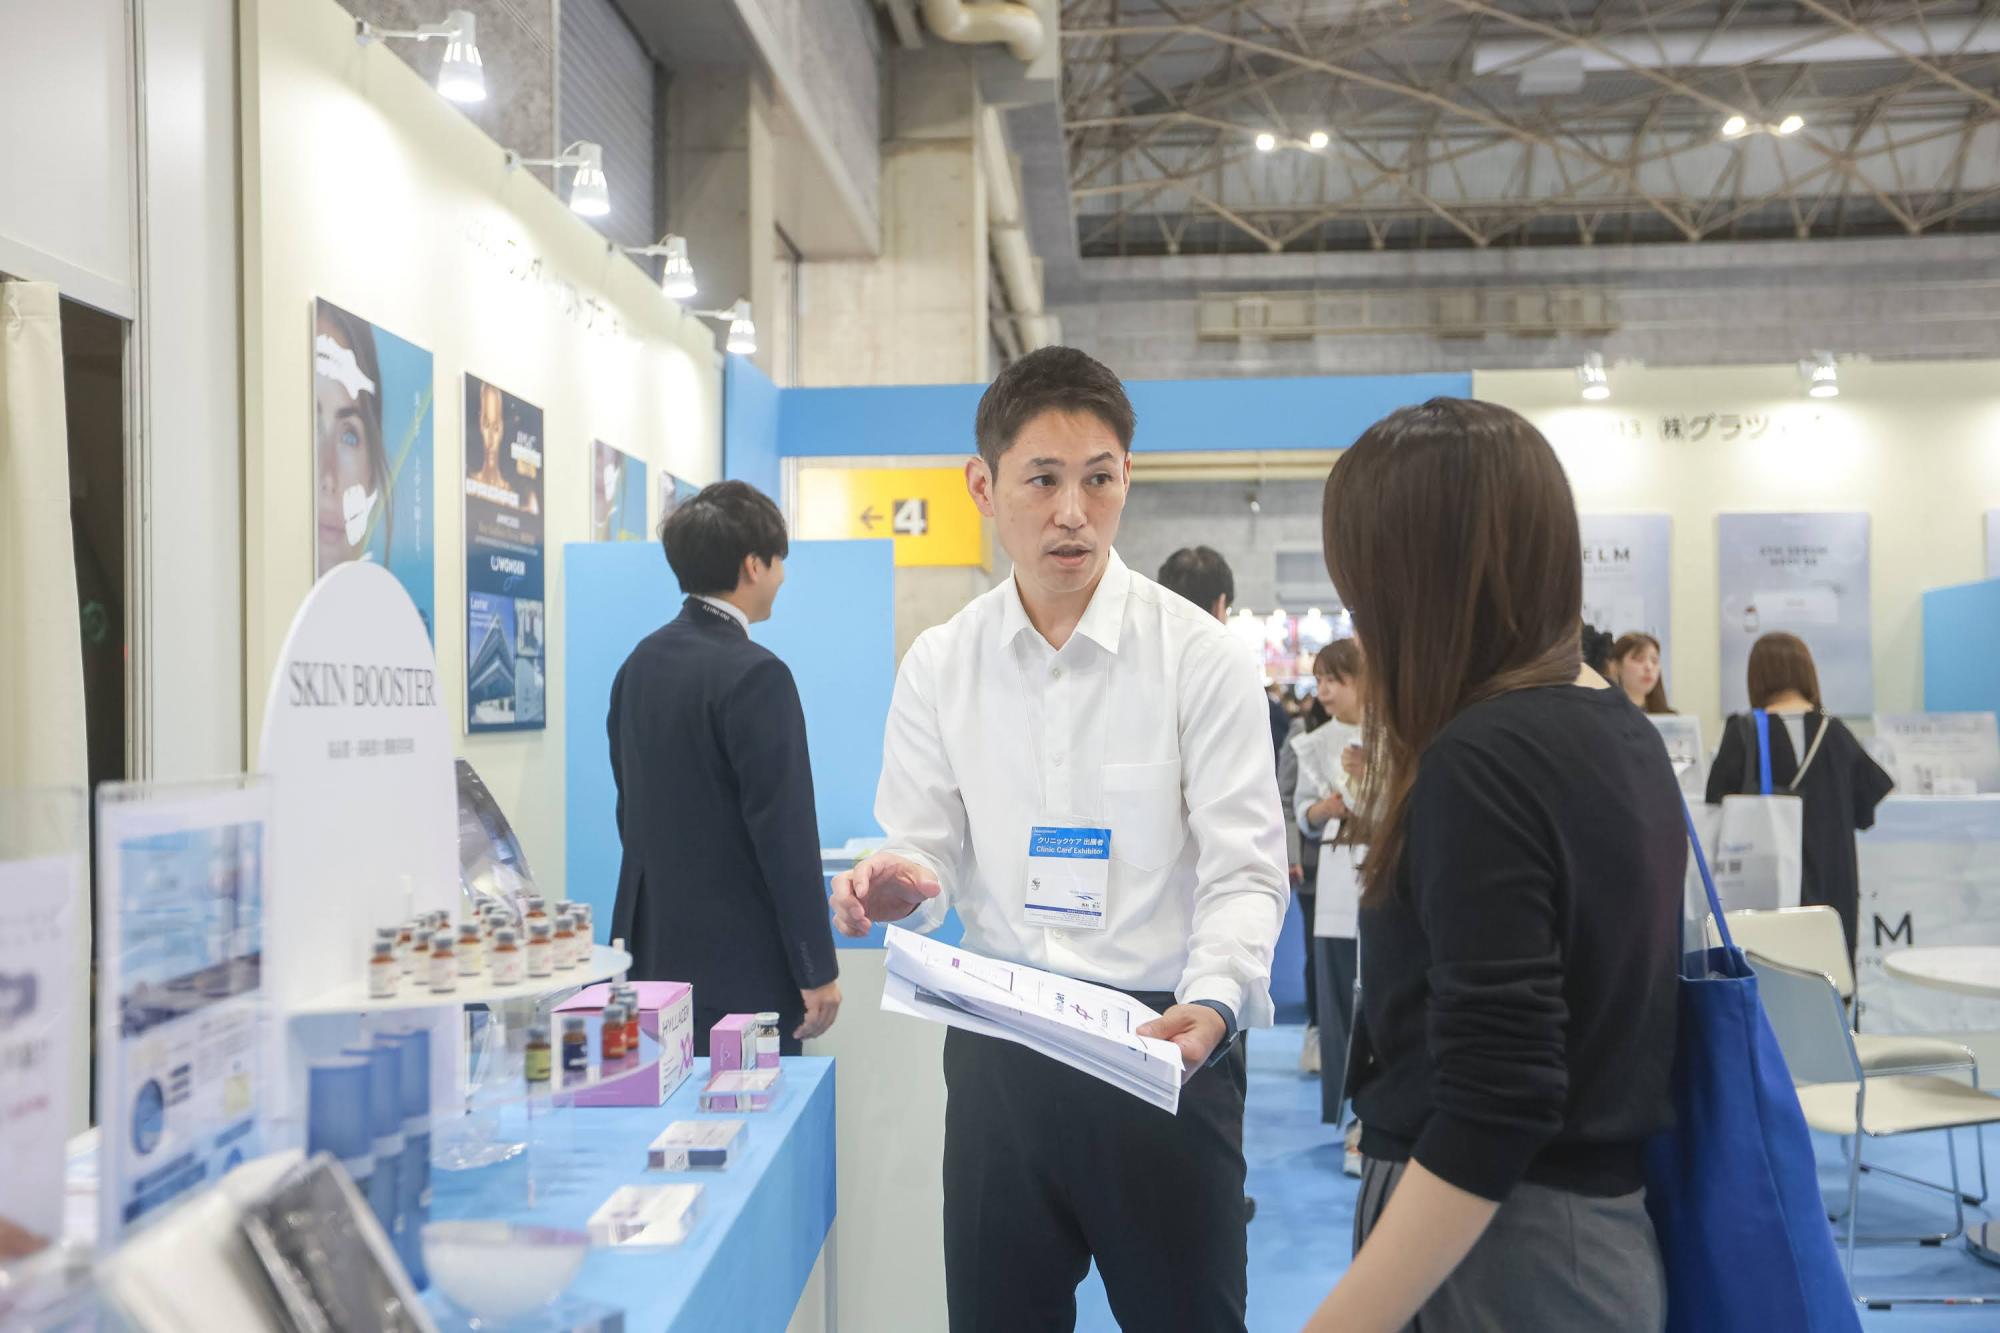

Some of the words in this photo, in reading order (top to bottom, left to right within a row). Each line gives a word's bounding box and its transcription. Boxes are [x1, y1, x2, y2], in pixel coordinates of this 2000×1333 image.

[893, 498, 928, 535] 4
[1583, 548, 1631, 563] ELM
[289, 661, 347, 707] SKIN
[353, 664, 437, 708] BOOSTER
[1038, 837, 1082, 845] クリニックケア
[1073, 847, 1104, 855] Exhibitor
